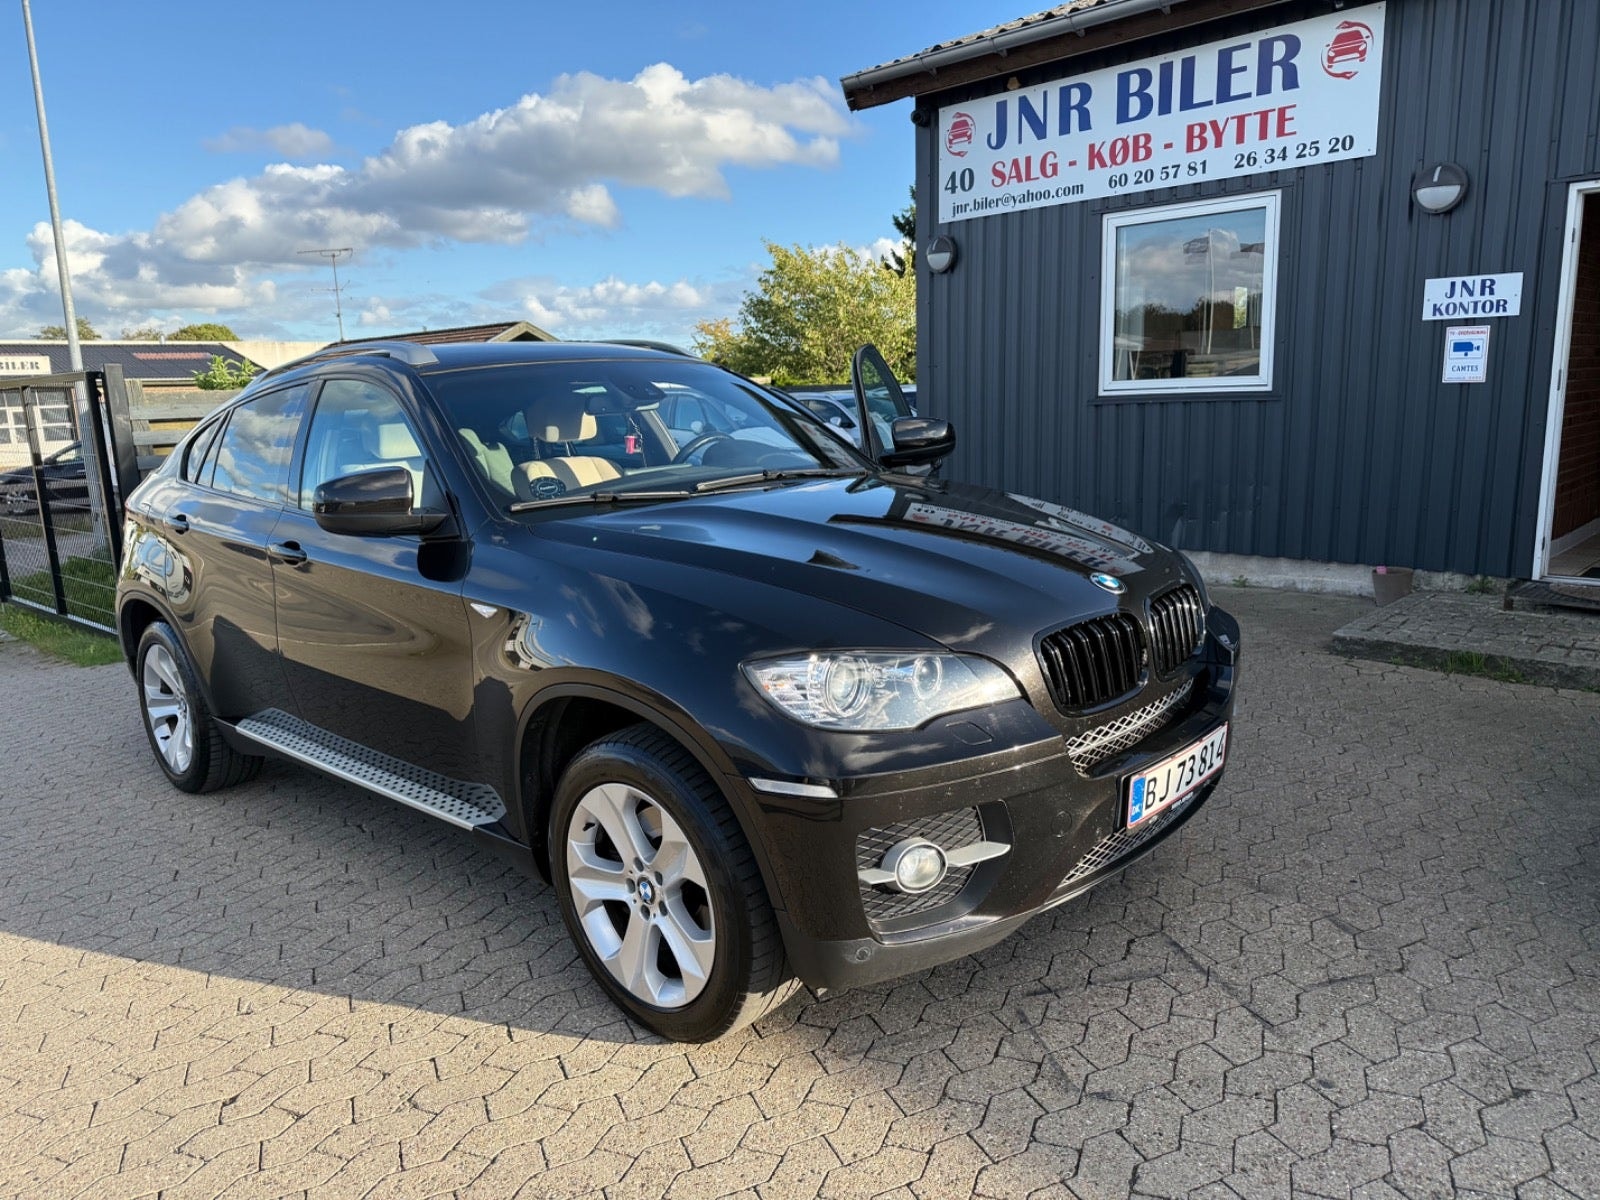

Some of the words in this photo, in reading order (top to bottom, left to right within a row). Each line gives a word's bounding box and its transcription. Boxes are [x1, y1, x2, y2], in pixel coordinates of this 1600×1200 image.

[986, 81, 1093, 150] JNR
[1116, 33, 1302, 125] BILER
[991, 151, 1058, 188] SALG
[1088, 133, 1153, 171] KØB
[1186, 104, 1297, 154] BYTTE
[1234, 150, 1258, 169] 26
[1264, 145, 1288, 164] 34
[1295, 140, 1320, 159] 25
[1327, 134, 1355, 154] 20
[944, 167, 975, 195] 40
[1108, 173, 1128, 189] 60
[1134, 168, 1154, 185] 20
[1160, 164, 1181, 181] 57
[1187, 159, 1207, 176] 81
[951, 183, 1085, 218] jnr.biler@yahoo.com
[1444, 278, 1496, 299] JNR
[1432, 298, 1509, 317] KONTOR
[1144, 768, 1172, 810] BJ
[1175, 754, 1196, 793] 73
